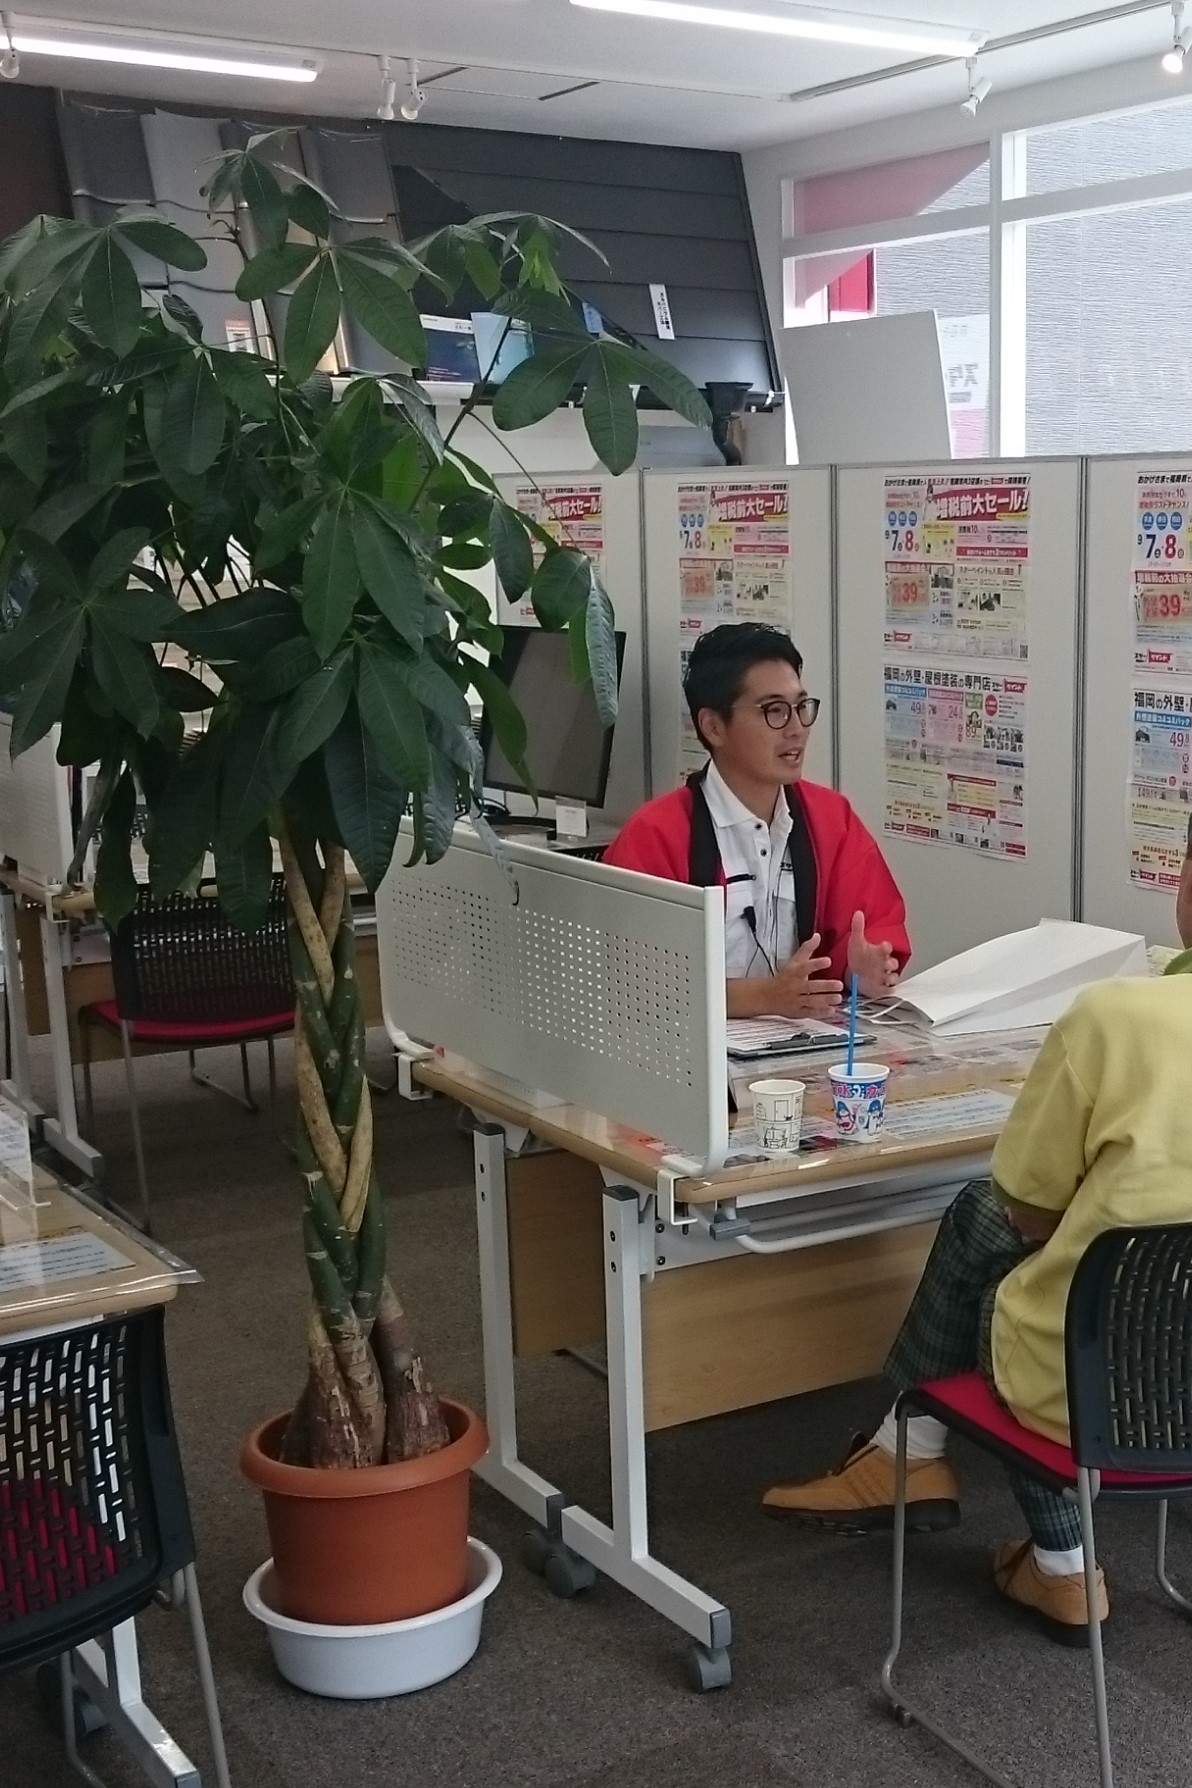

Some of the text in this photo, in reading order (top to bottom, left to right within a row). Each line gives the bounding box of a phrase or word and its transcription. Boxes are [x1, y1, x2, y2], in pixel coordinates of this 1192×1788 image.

[905, 530, 914, 551] 8
[1145, 534, 1157, 559] 7
[1165, 534, 1176, 559] 8
